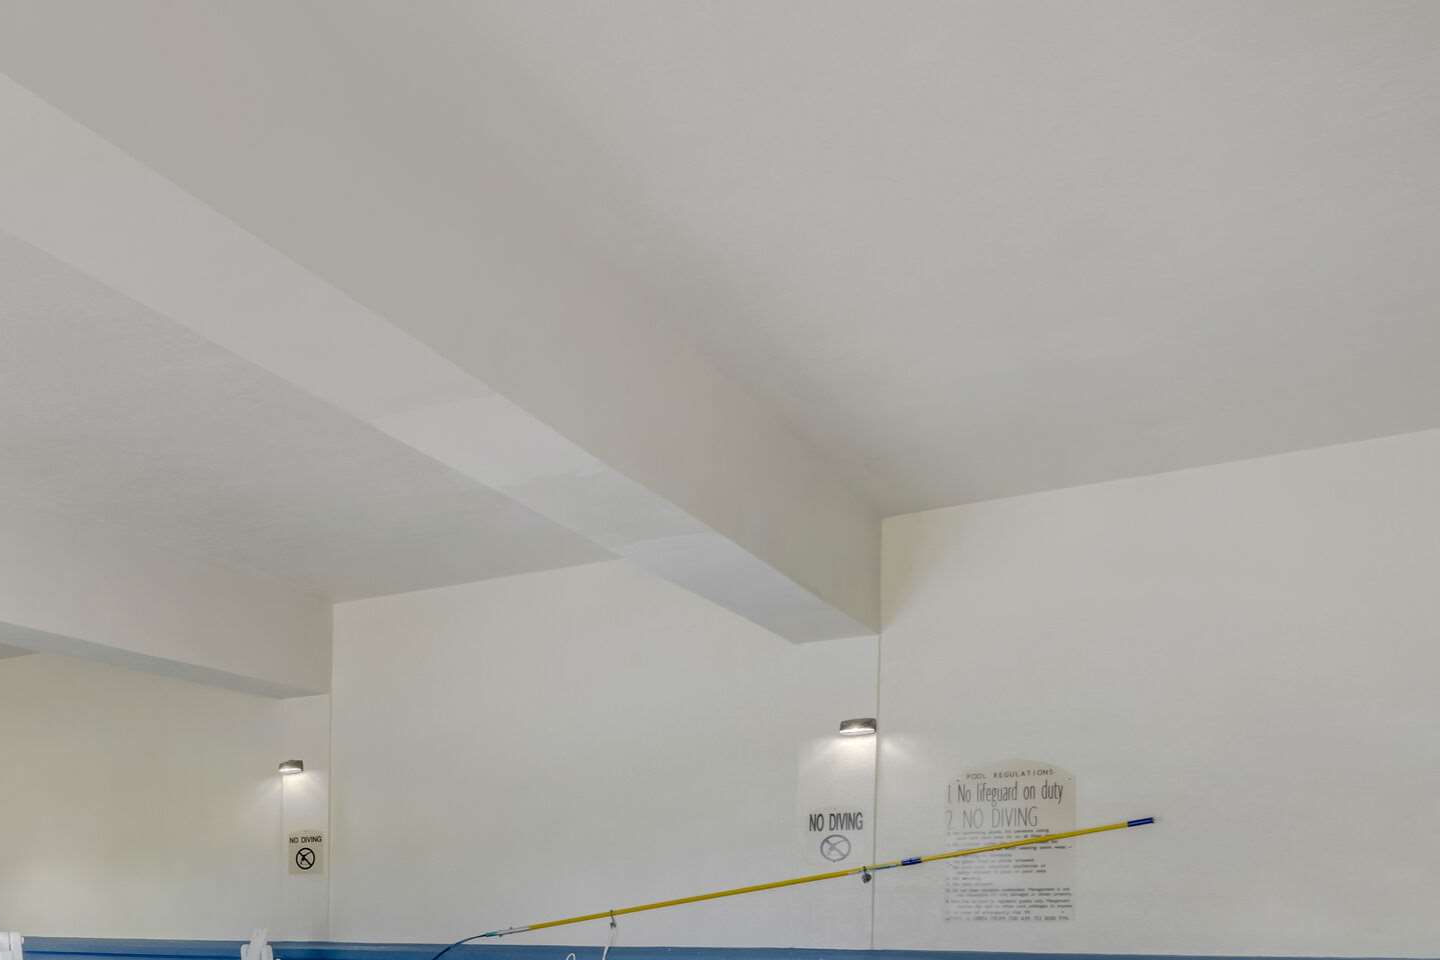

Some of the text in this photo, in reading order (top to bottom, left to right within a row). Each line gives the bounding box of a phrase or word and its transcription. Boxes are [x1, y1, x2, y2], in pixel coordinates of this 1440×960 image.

[993, 769, 1055, 778] REGULATIONS
[957, 781, 971, 803] No
[976, 780, 1018, 807] lifeguard
[1023, 785, 1036, 800] on
[1041, 780, 1064, 804] duty
[809, 811, 863, 831] NO DIVING
[962, 808, 984, 829] NO
[991, 806, 1038, 829] DIVING
[301, 835, 322, 843] DIVING
